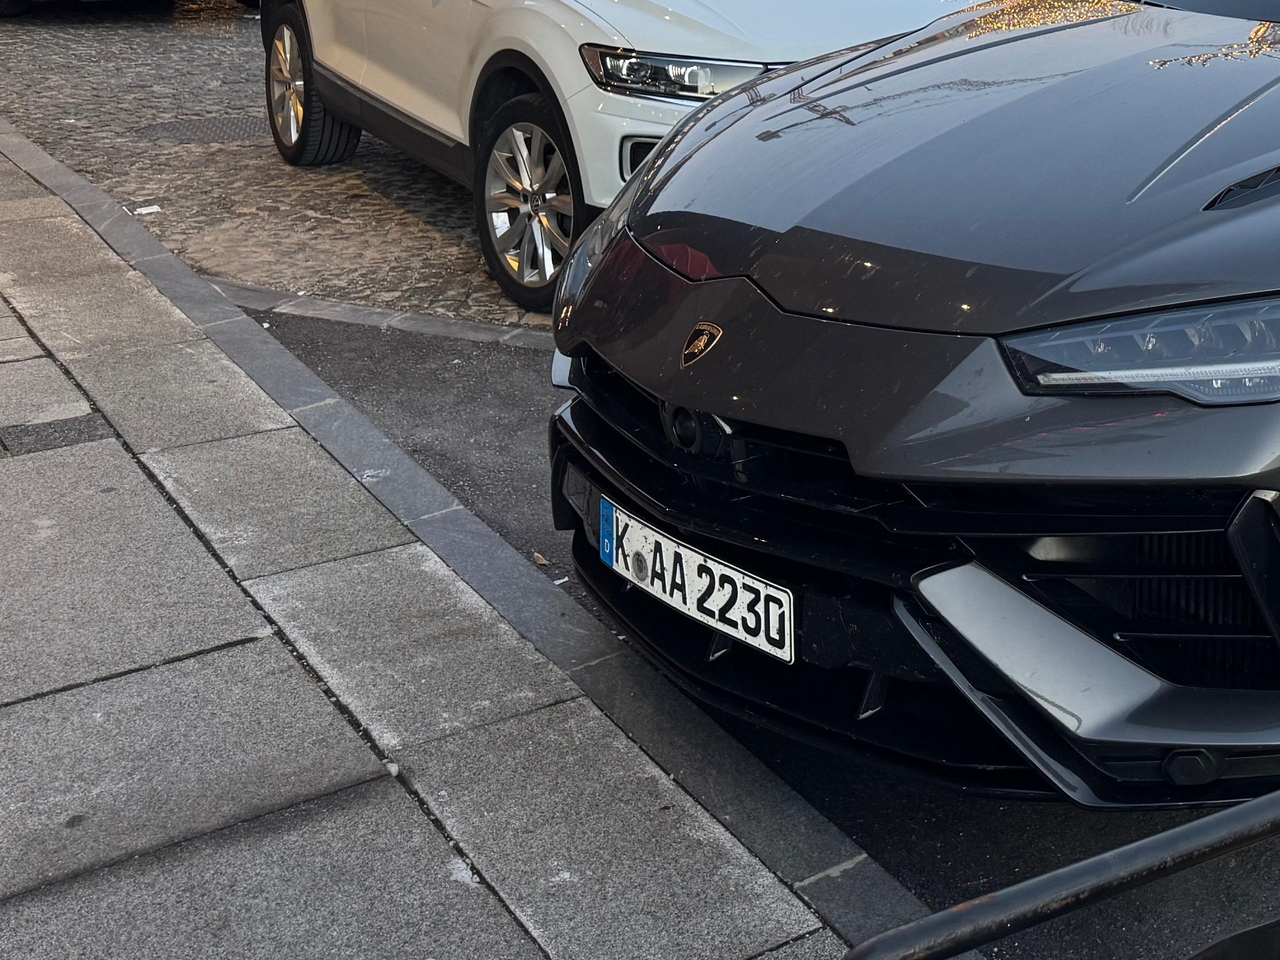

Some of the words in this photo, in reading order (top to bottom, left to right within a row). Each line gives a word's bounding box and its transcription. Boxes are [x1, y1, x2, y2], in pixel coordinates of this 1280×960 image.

[615, 515, 630, 572] K
[650, 539, 688, 606] AA
[697, 563, 786, 650] 2230
